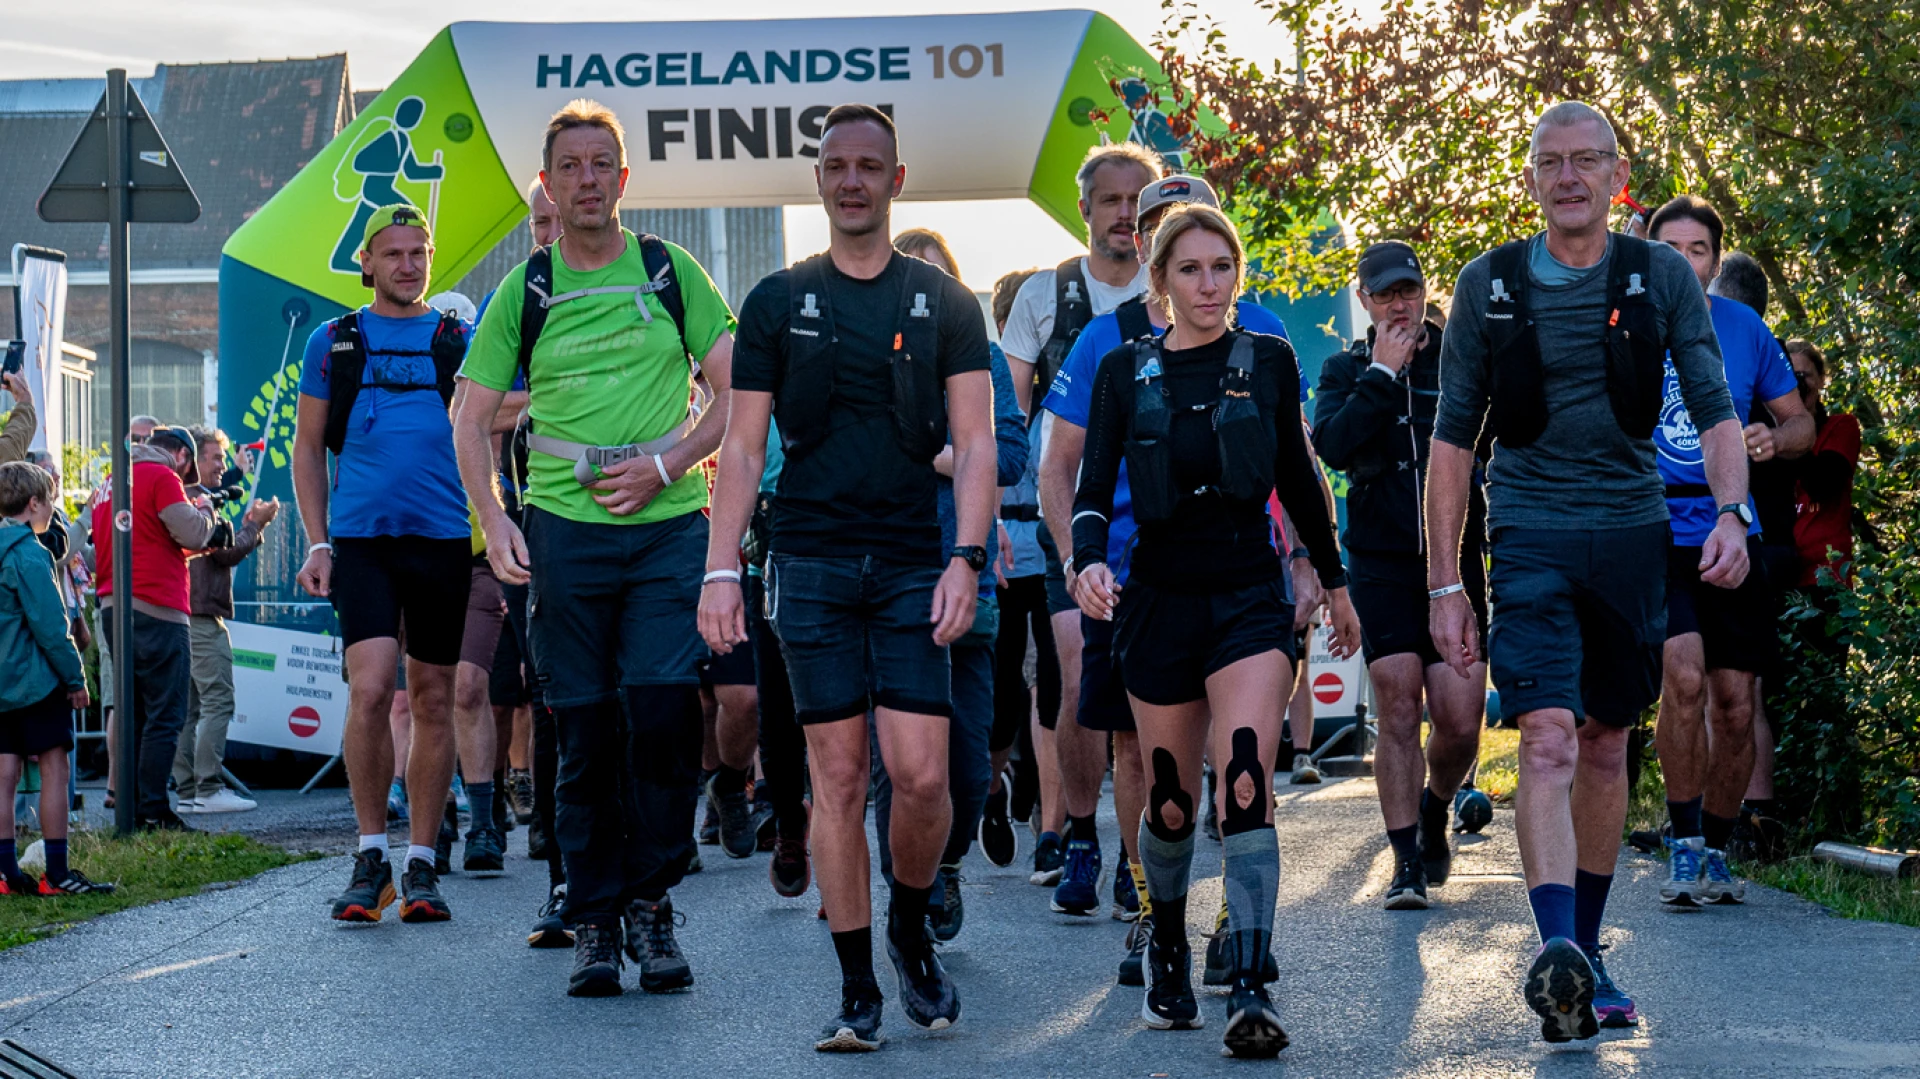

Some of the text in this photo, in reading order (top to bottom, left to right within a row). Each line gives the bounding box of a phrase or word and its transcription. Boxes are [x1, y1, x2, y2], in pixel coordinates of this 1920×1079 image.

[536, 43, 1005, 88] HAGELANDSE 101
[647, 102, 895, 161] FINIS
[287, 657, 340, 674] VOOR BEWONERS
[306, 674, 316, 684] EN
[286, 684, 333, 700] HULPDIENSTEN
